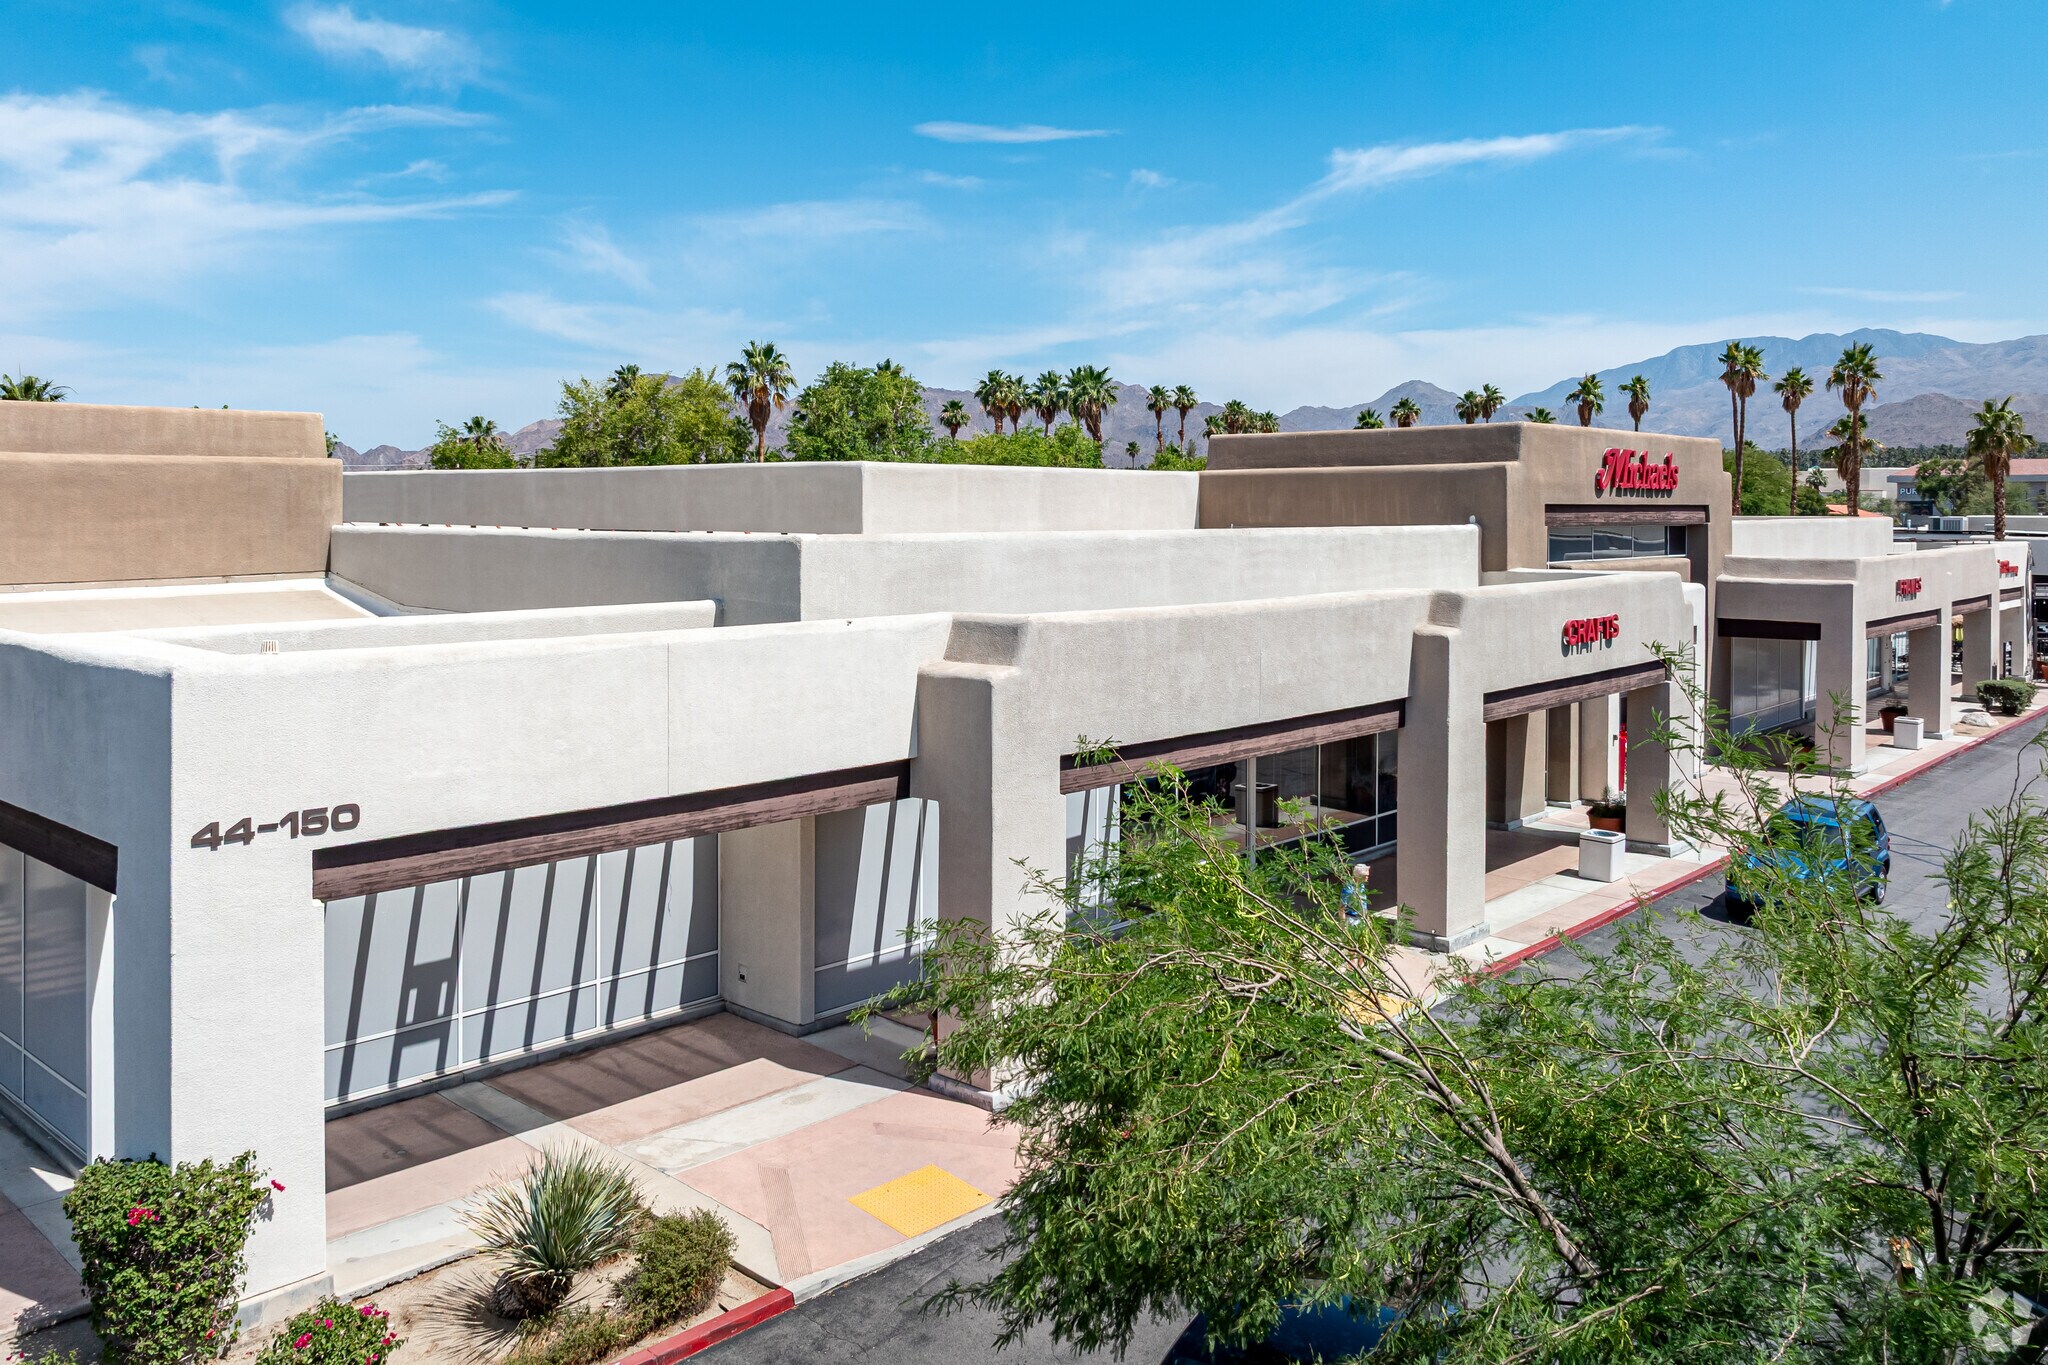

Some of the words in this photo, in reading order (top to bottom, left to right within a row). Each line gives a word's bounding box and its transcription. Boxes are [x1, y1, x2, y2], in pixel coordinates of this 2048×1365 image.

[1596, 448, 1679, 489] Michaels
[1563, 614, 1619, 646] CRAFTS
[191, 803, 360, 851] 44-150
